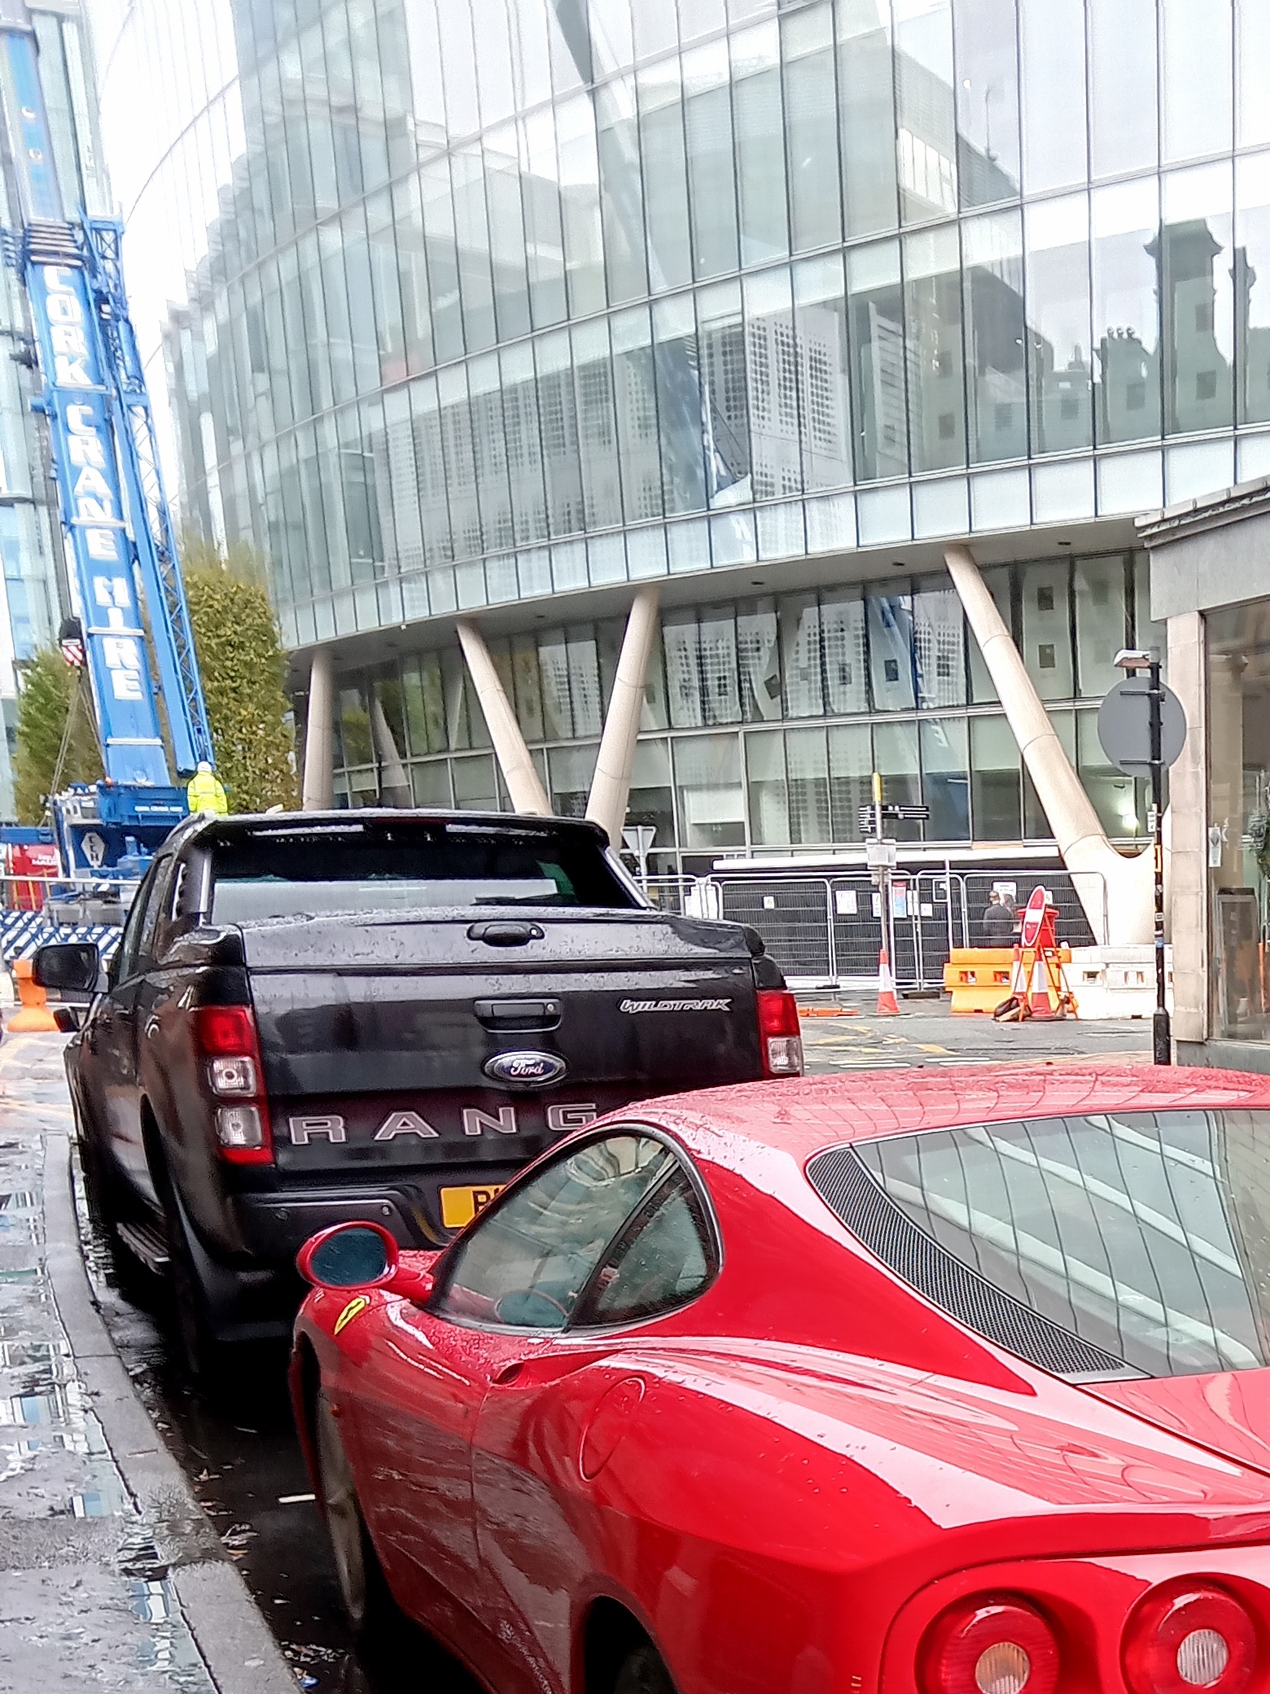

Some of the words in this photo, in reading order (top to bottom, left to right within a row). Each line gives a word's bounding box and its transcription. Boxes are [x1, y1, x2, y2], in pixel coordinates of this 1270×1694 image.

[43, 263, 93, 387] CORK
[65, 404, 118, 560] CRANE
[94, 575, 144, 701] HIRE
[620, 999, 732, 1014] WILDTRAK
[510, 1059, 544, 1075] Ford
[289, 1102, 597, 1145] RANG
